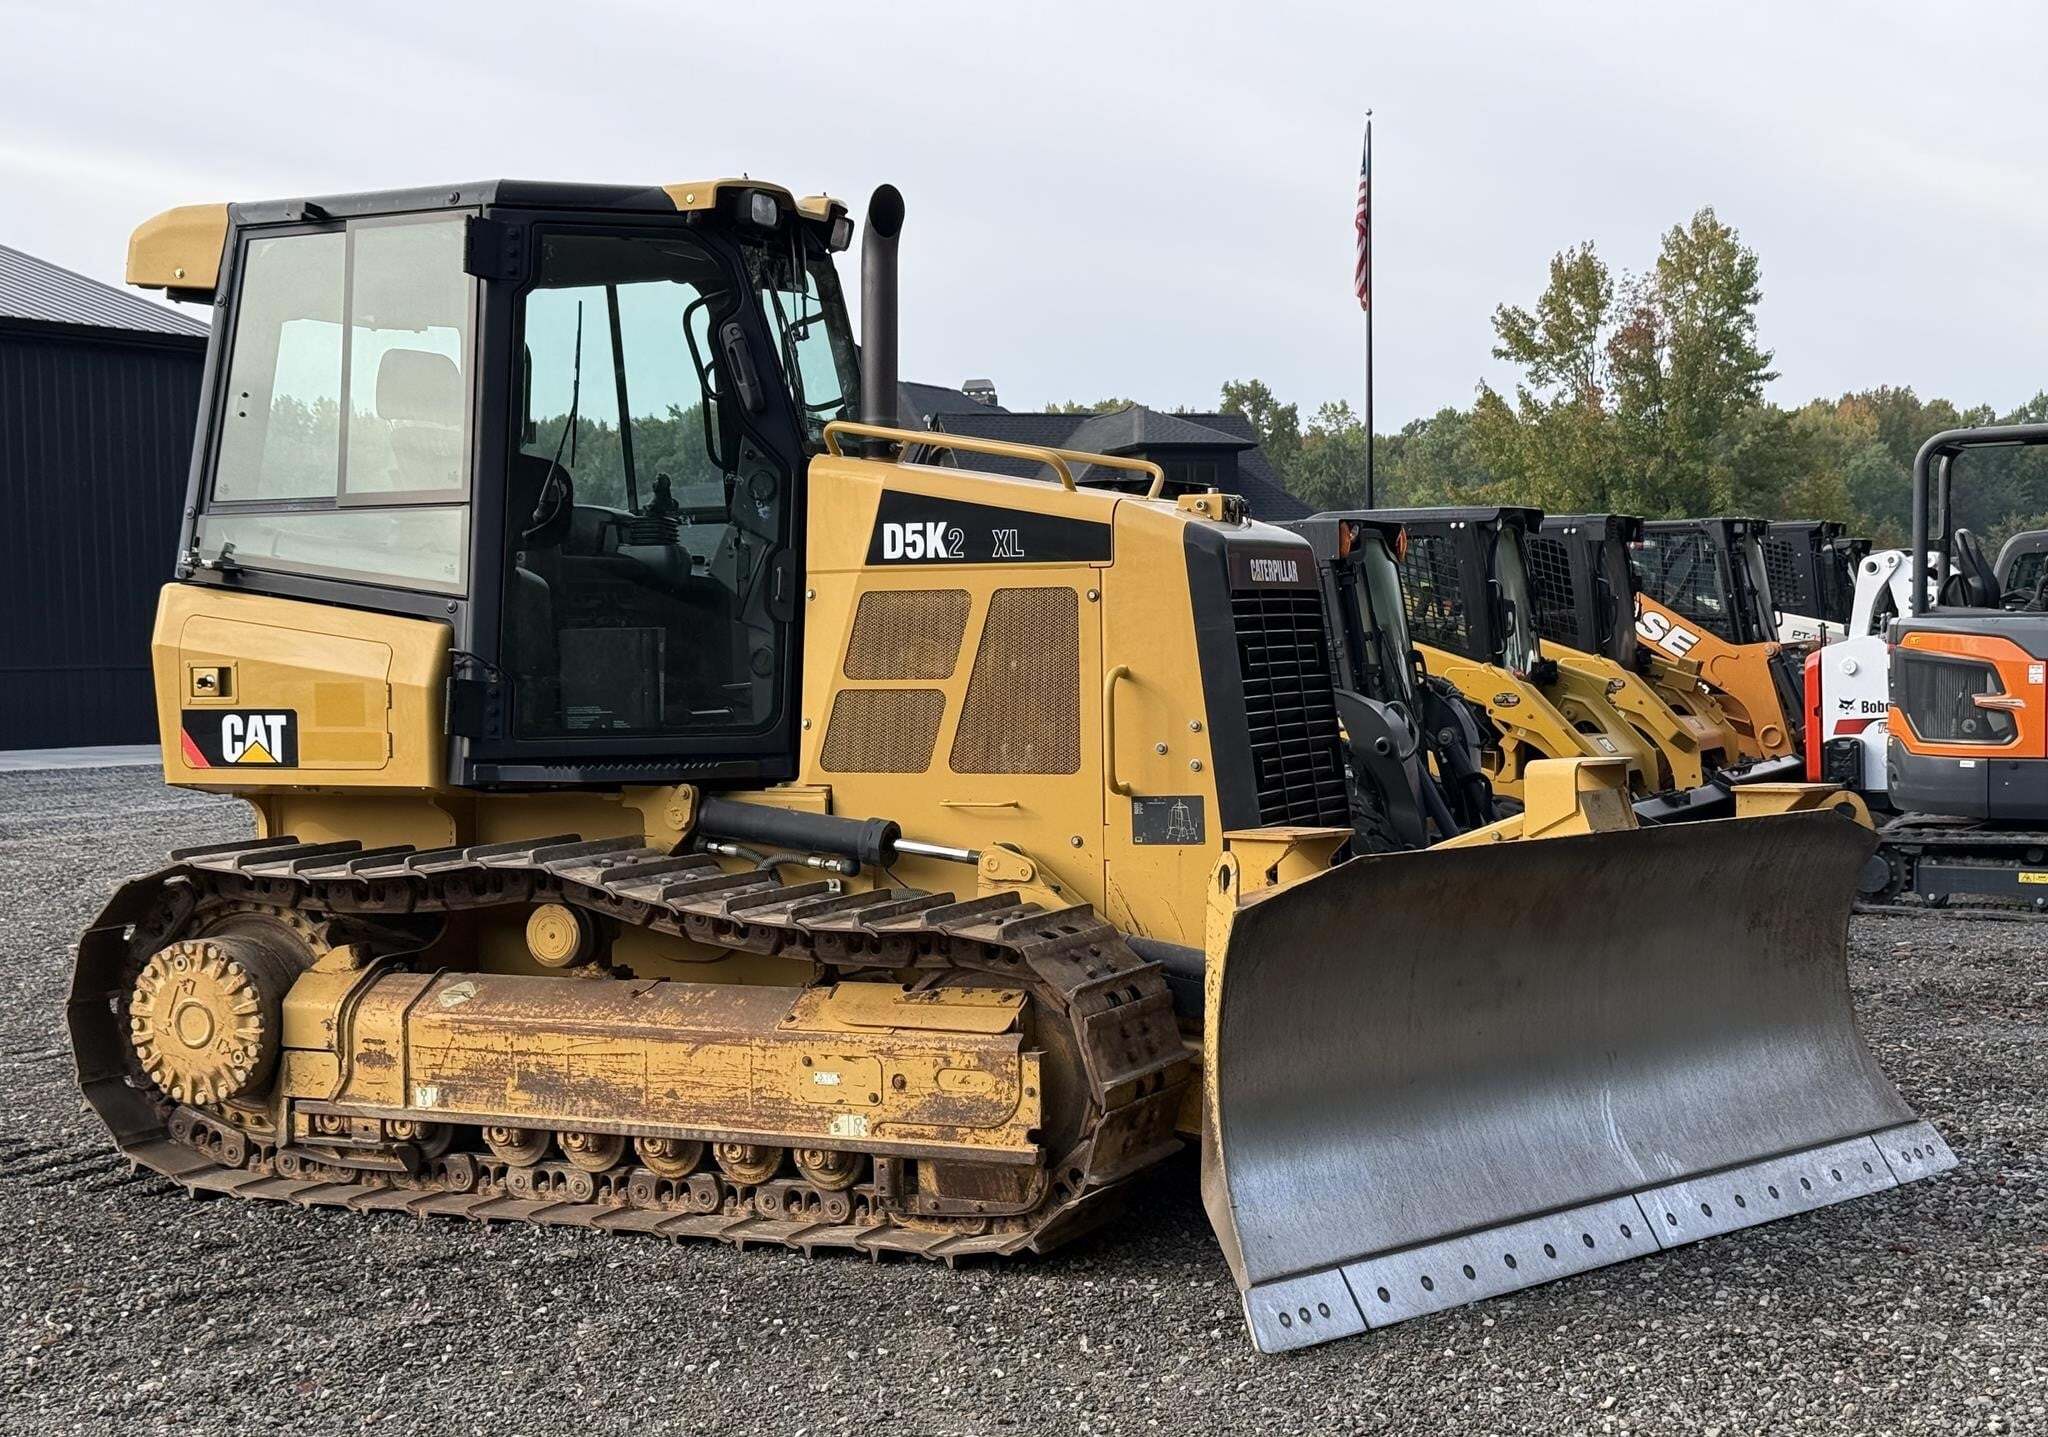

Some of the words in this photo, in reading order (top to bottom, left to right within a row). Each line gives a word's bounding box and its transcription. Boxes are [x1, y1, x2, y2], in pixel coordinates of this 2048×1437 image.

[883, 521, 965, 560] D5K2
[991, 529, 1025, 558] XL
[1249, 558, 1299, 583] CATERPILLAR
[1634, 603, 1701, 659] SE
[221, 713, 287, 763] CAT
